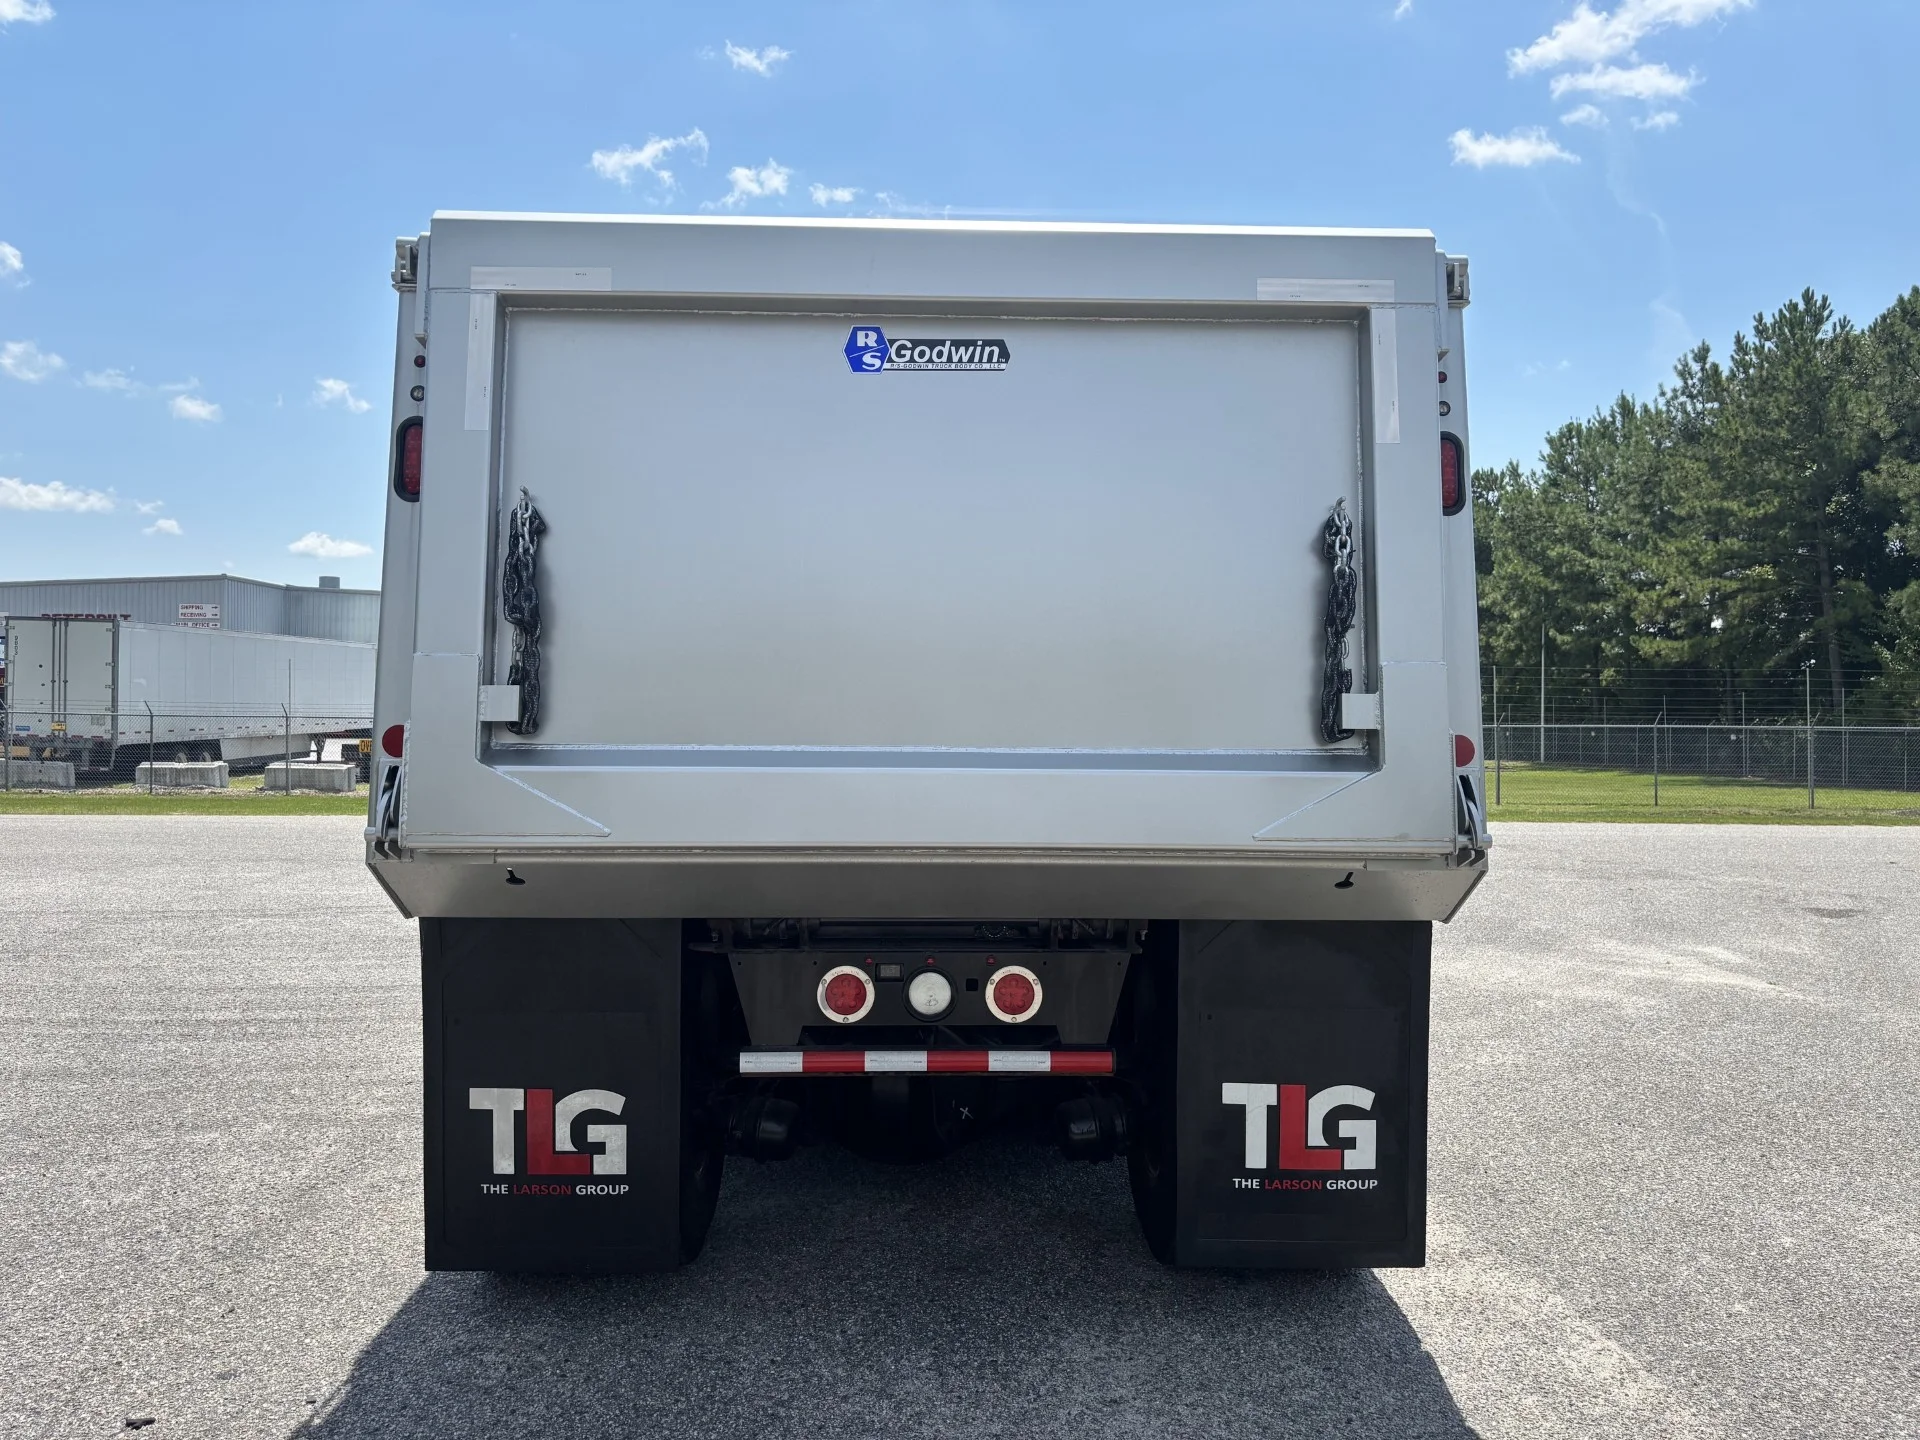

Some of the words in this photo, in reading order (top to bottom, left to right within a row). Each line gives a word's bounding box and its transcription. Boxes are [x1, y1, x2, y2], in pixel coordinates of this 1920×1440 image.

[857, 331, 877, 346] R
[890, 340, 1000, 363] Godwin
[862, 353, 881, 370] S
[469, 1088, 627, 1175] TLG
[1222, 1083, 1377, 1170] TLG
[481, 1184, 509, 1195] THE
[513, 1184, 572, 1195] LARSON
[575, 1184, 629, 1195] GROUP
[1232, 1178, 1260, 1189] THE
[1264, 1179, 1322, 1190] LARSON
[1326, 1179, 1378, 1190] GROUP
